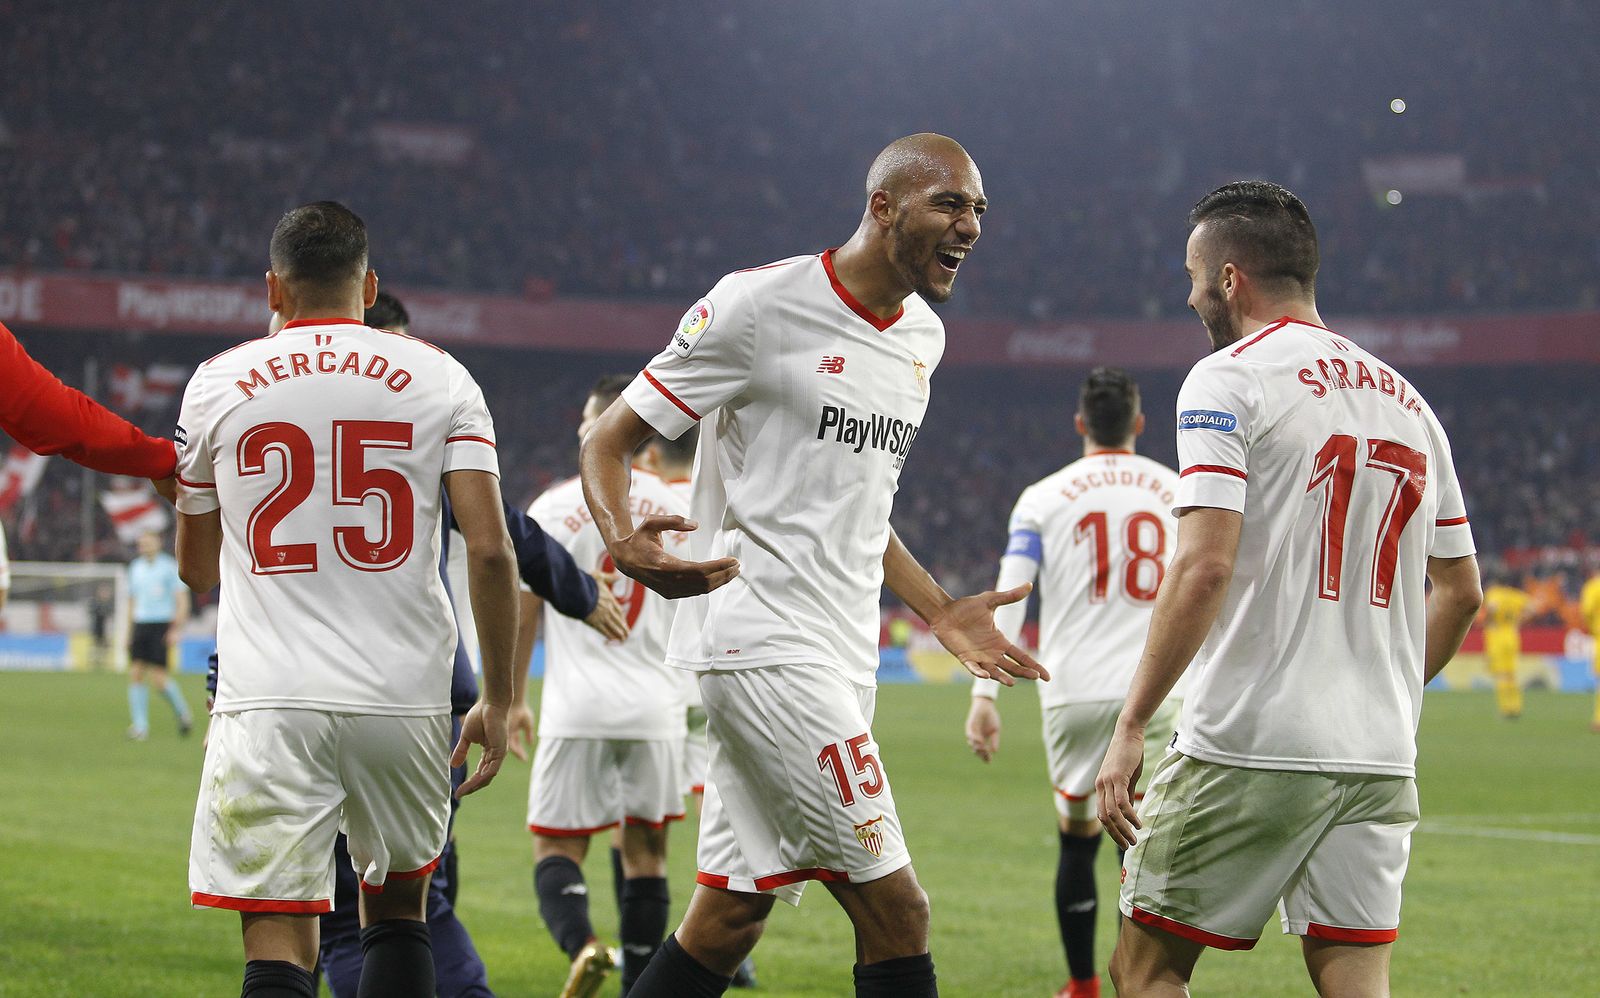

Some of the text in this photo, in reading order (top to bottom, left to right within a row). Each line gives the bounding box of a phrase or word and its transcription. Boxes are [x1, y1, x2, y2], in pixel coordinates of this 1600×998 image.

[234, 351, 413, 400] MERCADO
[236, 420, 415, 576] 25
[1060, 471, 1175, 505] ESCUDERO
[1306, 433, 1427, 609] 17
[1073, 510, 1166, 608] 18
[816, 732, 885, 808] 15
